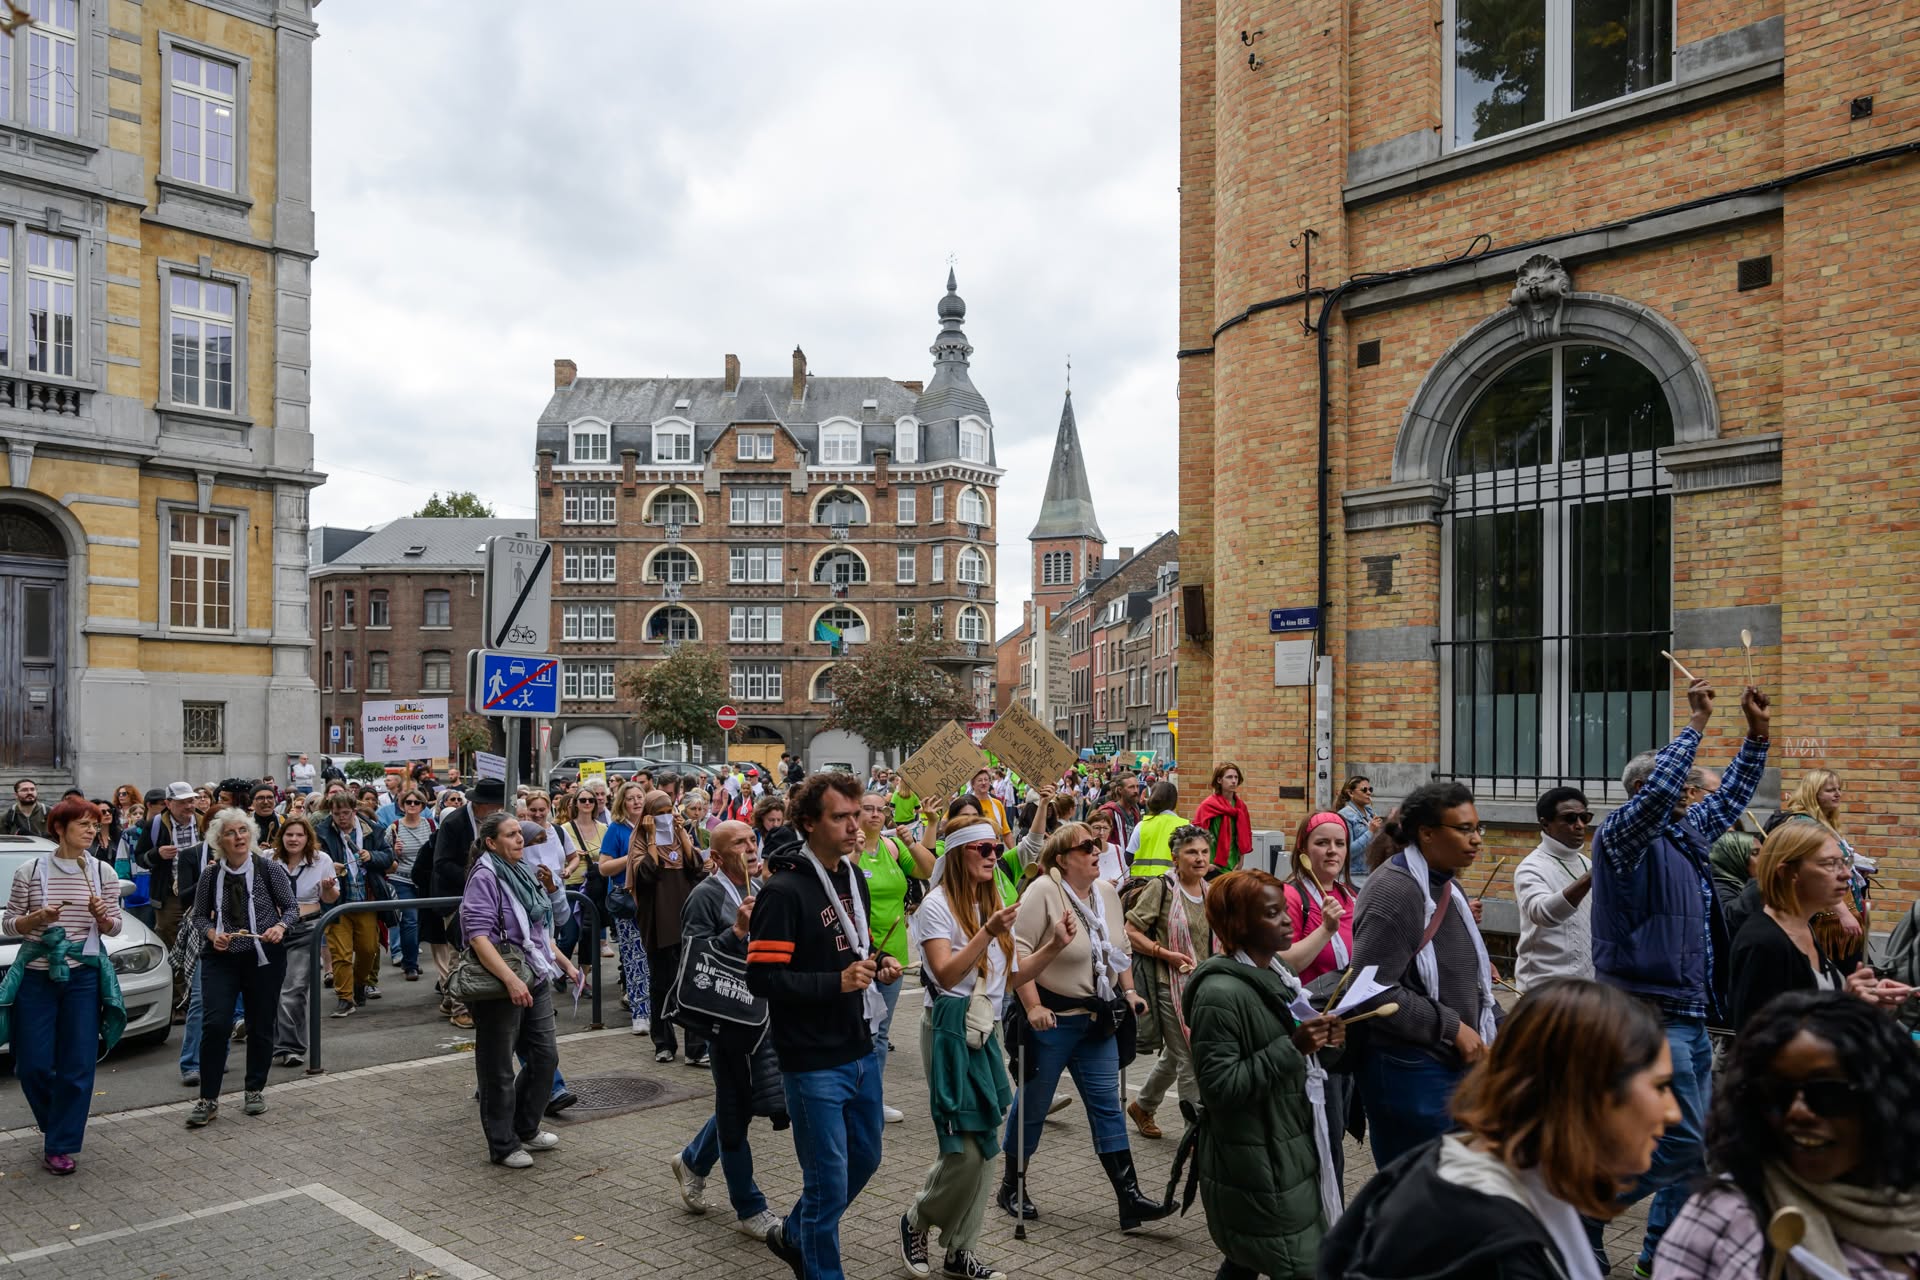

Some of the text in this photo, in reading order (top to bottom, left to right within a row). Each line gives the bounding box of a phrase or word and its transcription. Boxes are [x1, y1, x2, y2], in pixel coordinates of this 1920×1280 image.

[508, 541, 541, 557] ZONE
[377, 713, 420, 722] méritocratie
[420, 712, 444, 720] comme
[367, 724, 394, 733] modèle
[394, 722, 425, 734] politique
[995, 723, 1015, 743] PLUS
[1785, 736, 1826, 758] NON
[905, 756, 928, 780] STOP
[933, 750, 959, 774] PLACE
